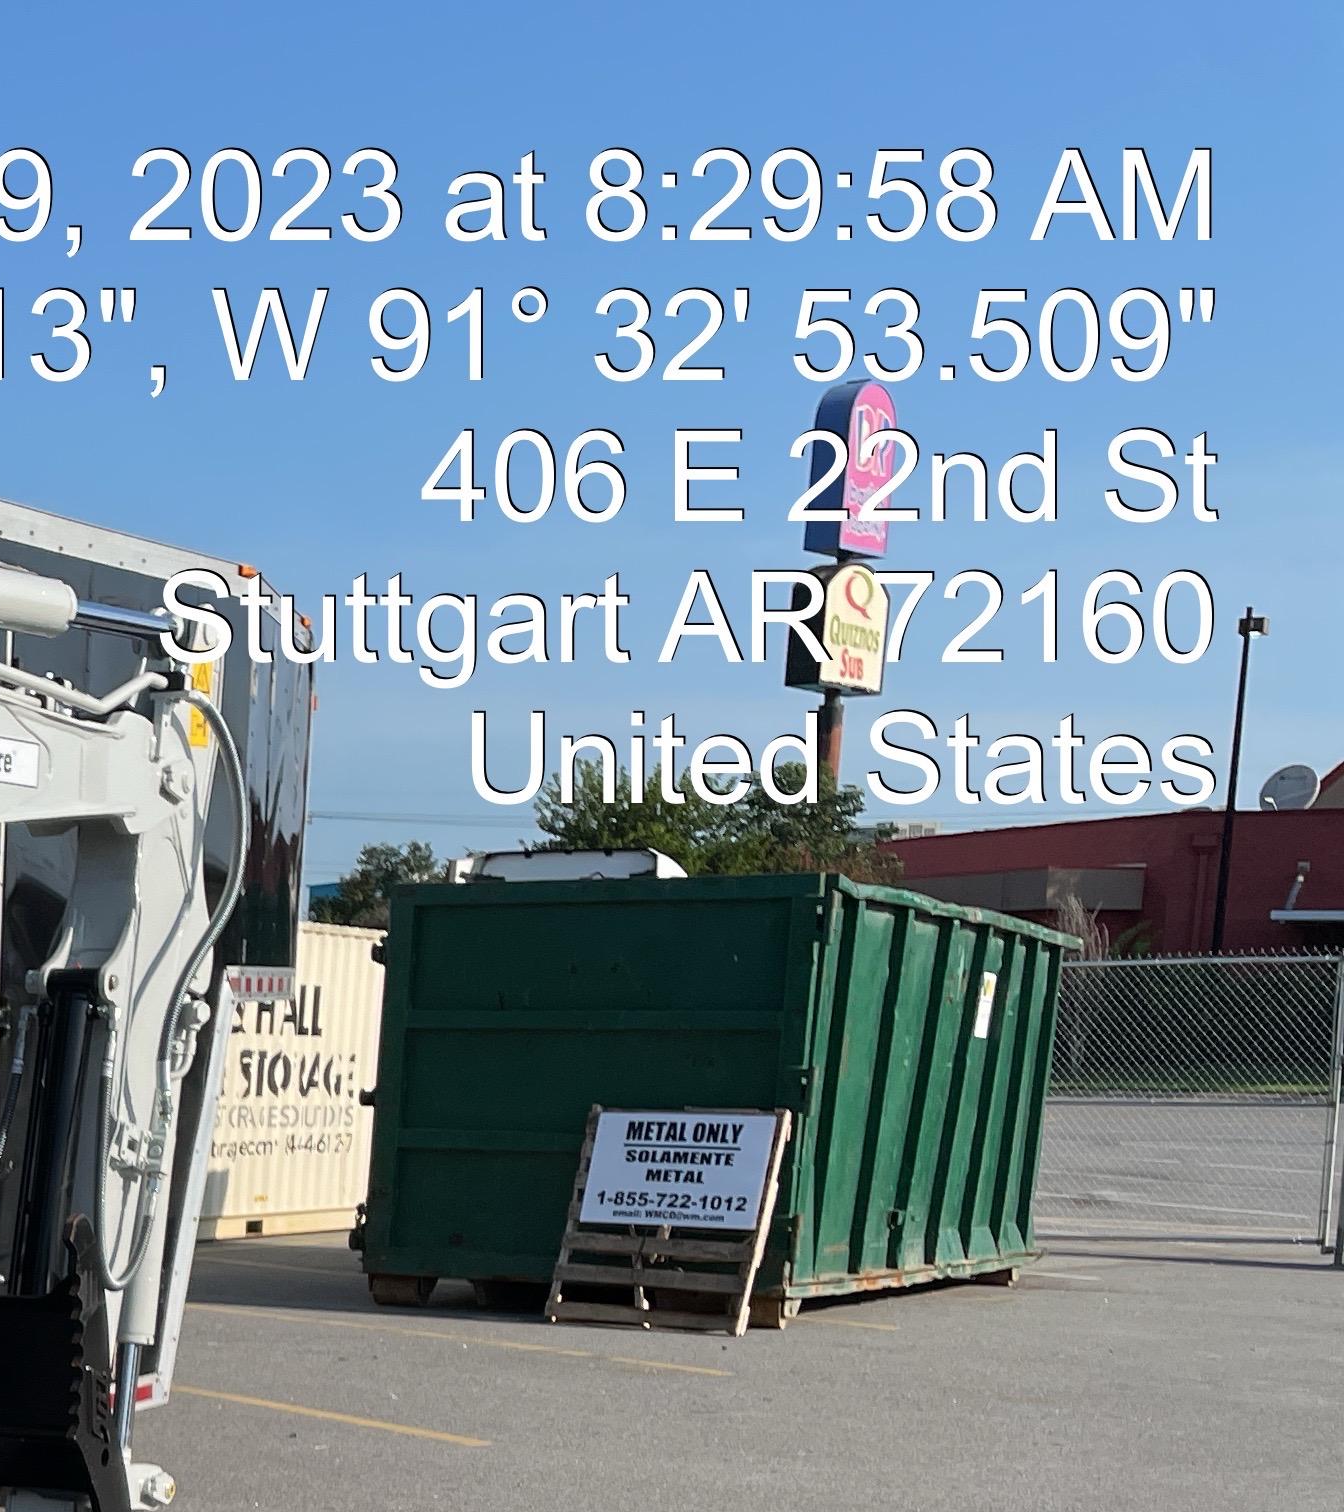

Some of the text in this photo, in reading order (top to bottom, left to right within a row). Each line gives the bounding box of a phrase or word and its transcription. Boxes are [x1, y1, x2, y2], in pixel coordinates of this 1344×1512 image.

[626, 1120, 744, 1144] METAL ONLY
[625, 1149, 735, 1167] SOLAMENTE
[645, 1168, 705, 1184] METAL
[597, 1190, 748, 1212] 1-855-722-1012
